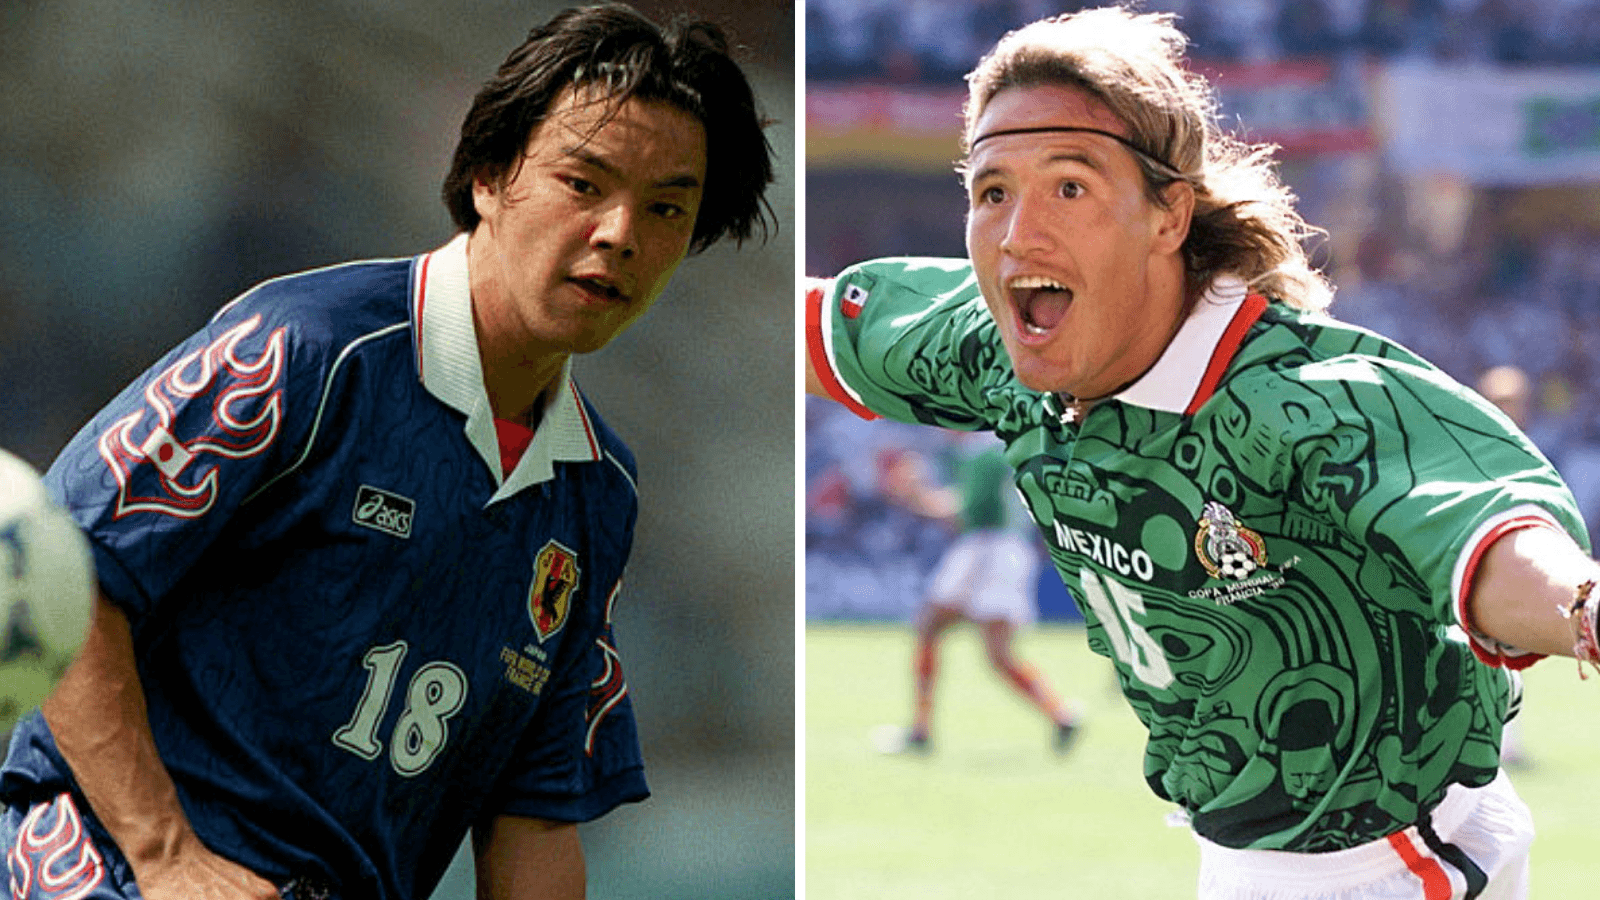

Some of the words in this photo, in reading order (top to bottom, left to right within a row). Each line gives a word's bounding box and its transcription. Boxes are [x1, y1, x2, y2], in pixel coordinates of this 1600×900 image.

[1053, 518, 1154, 581] MEXICO
[1079, 566, 1176, 689] 15
[332, 639, 468, 777] 18
